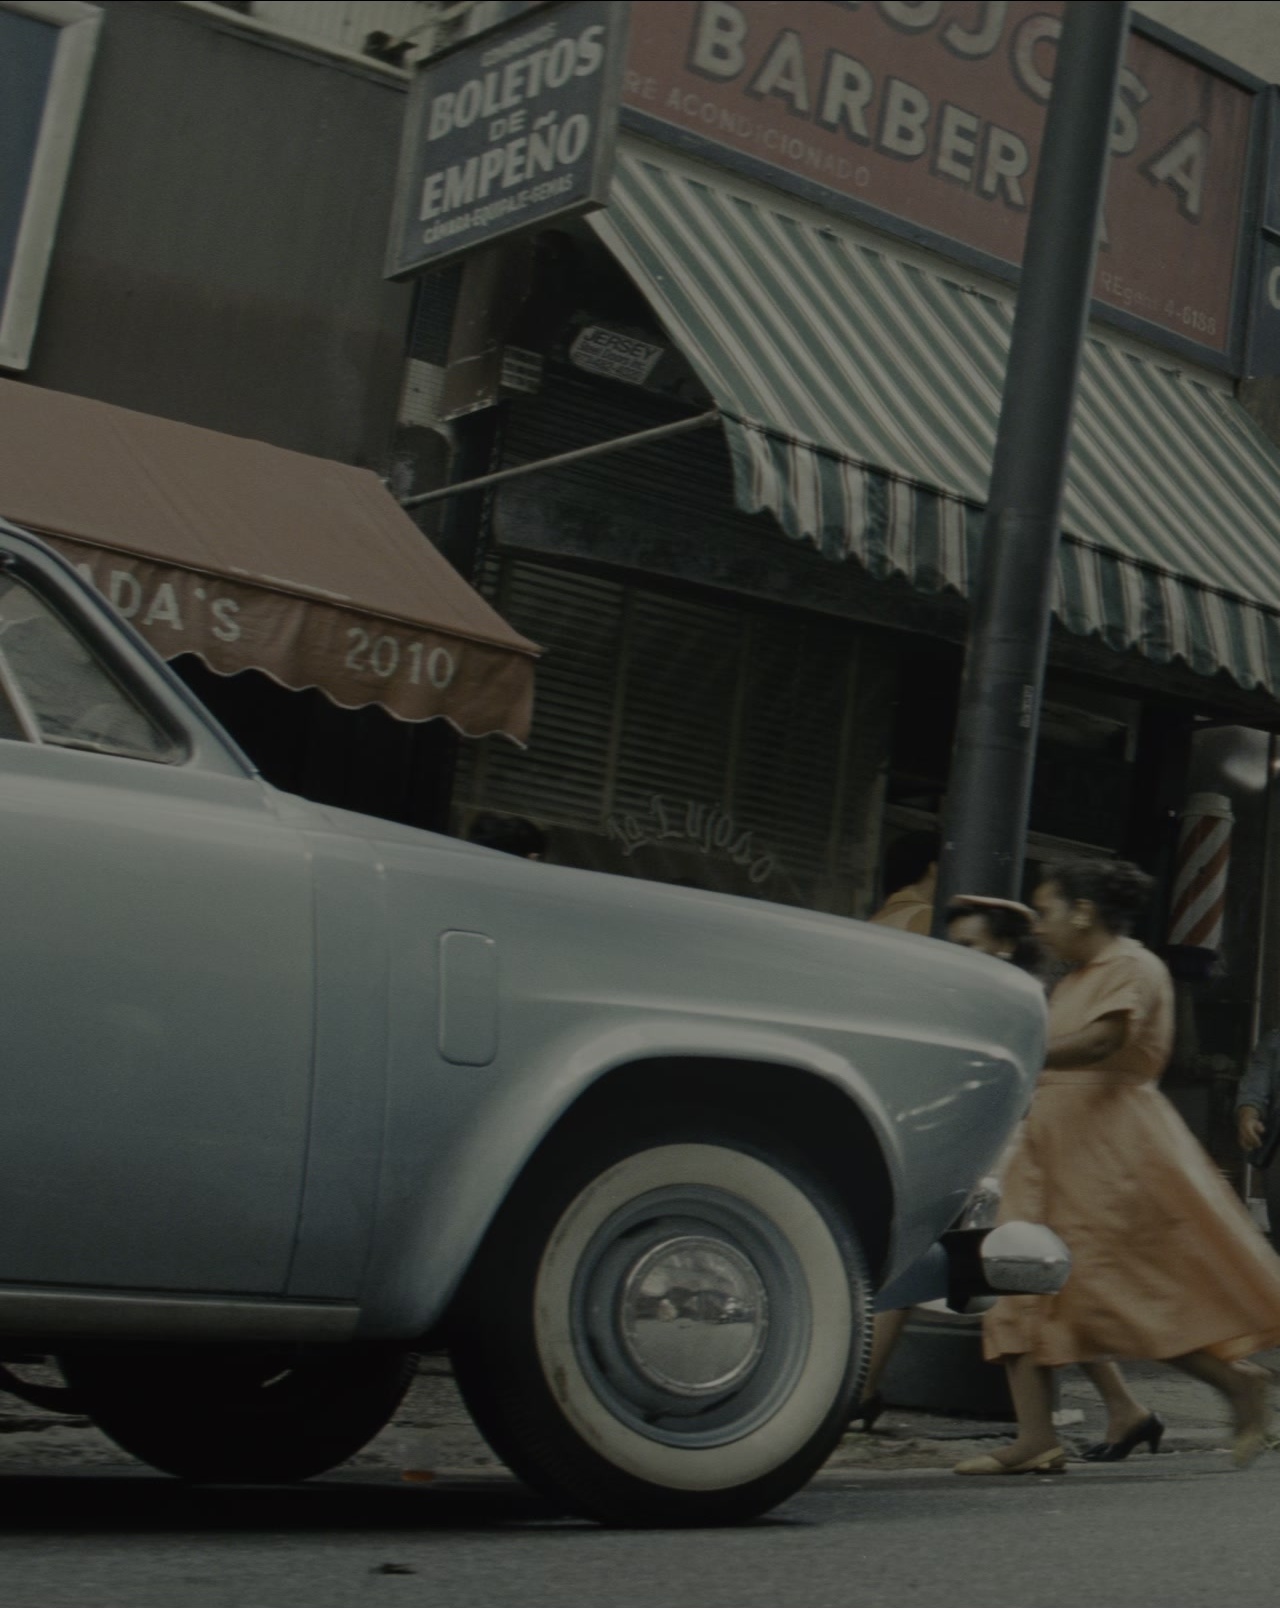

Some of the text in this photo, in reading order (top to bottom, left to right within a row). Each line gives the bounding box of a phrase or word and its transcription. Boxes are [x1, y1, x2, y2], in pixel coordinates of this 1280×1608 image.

[428, 25, 606, 141] BOLETOS
[419, 110, 591, 222] EMPEÑO
[488, 109, 529, 142] DE
[664, 86, 871, 188] ACONDICIONADO
[582, 328, 660, 360] JERSEY
[344, 626, 455, 690] 2010
